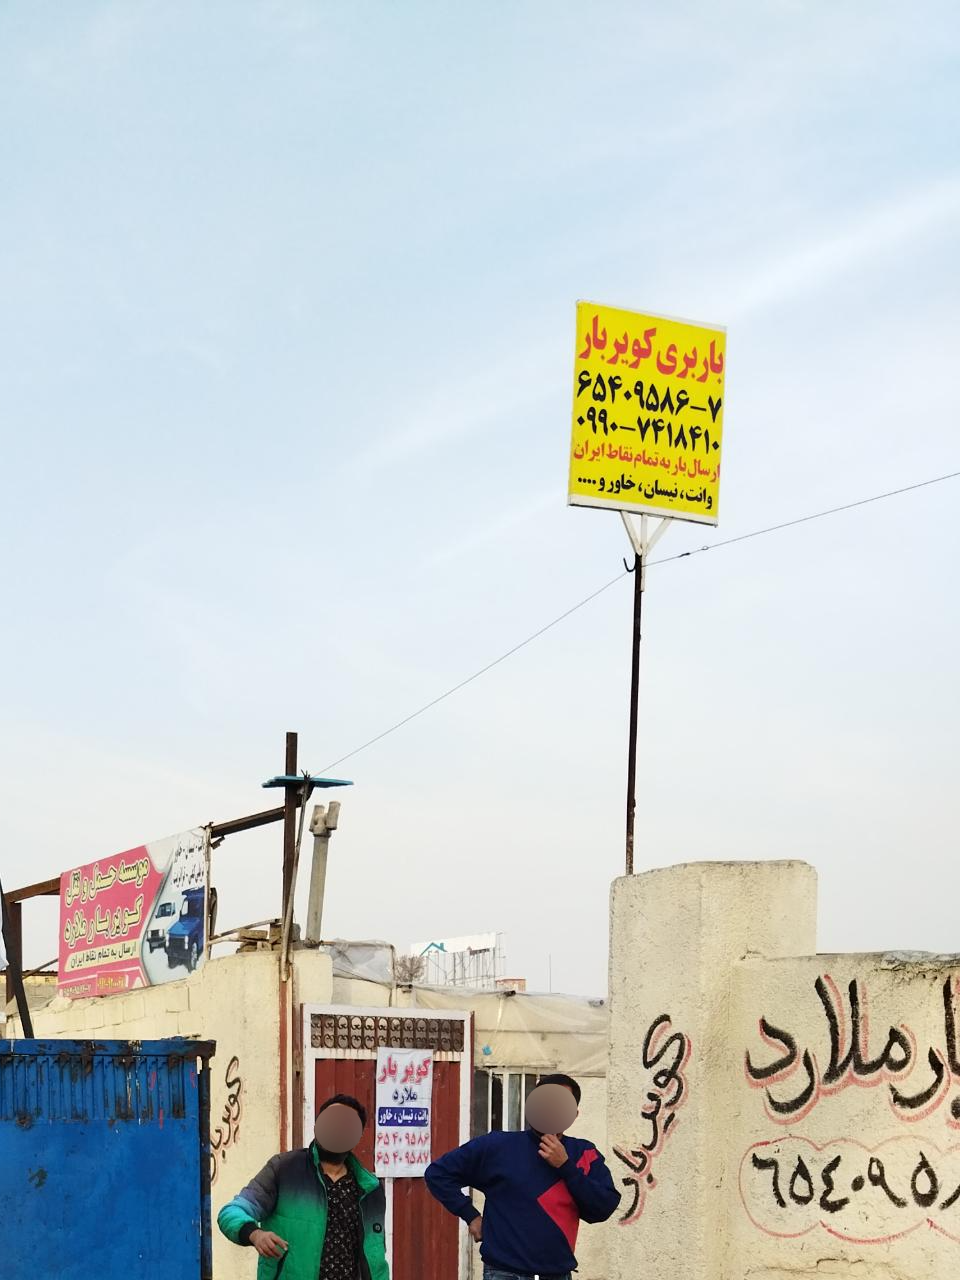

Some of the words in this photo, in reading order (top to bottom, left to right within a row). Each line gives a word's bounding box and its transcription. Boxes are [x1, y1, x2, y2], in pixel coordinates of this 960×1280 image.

[579, 314, 608, 361] بار
[607, 327, 657, 370] کویر
[656, 340, 724, 384] باربری
[574, 440, 605, 462] ایران
[607, 443, 633, 462] نقاط
[633, 449, 659, 469] تمام
[659, 456, 671, 474] به
[671, 456, 687, 477] بار
[687, 458, 720, 483] ارسال
[598, 477, 605, 491] و
[606, 473, 636, 494] خاور
[81, 876, 89, 903] و
[89, 862, 117, 899] حمل
[745, 974, 918, 1124] ملارد
[889, 974, 960, 1128] ار
[378, 1055, 398, 1084] بار
[400, 1058, 431, 1085] کویر
[392, 1087, 418, 1105] ملارد
[378, 1108, 393, 1124] خاور
